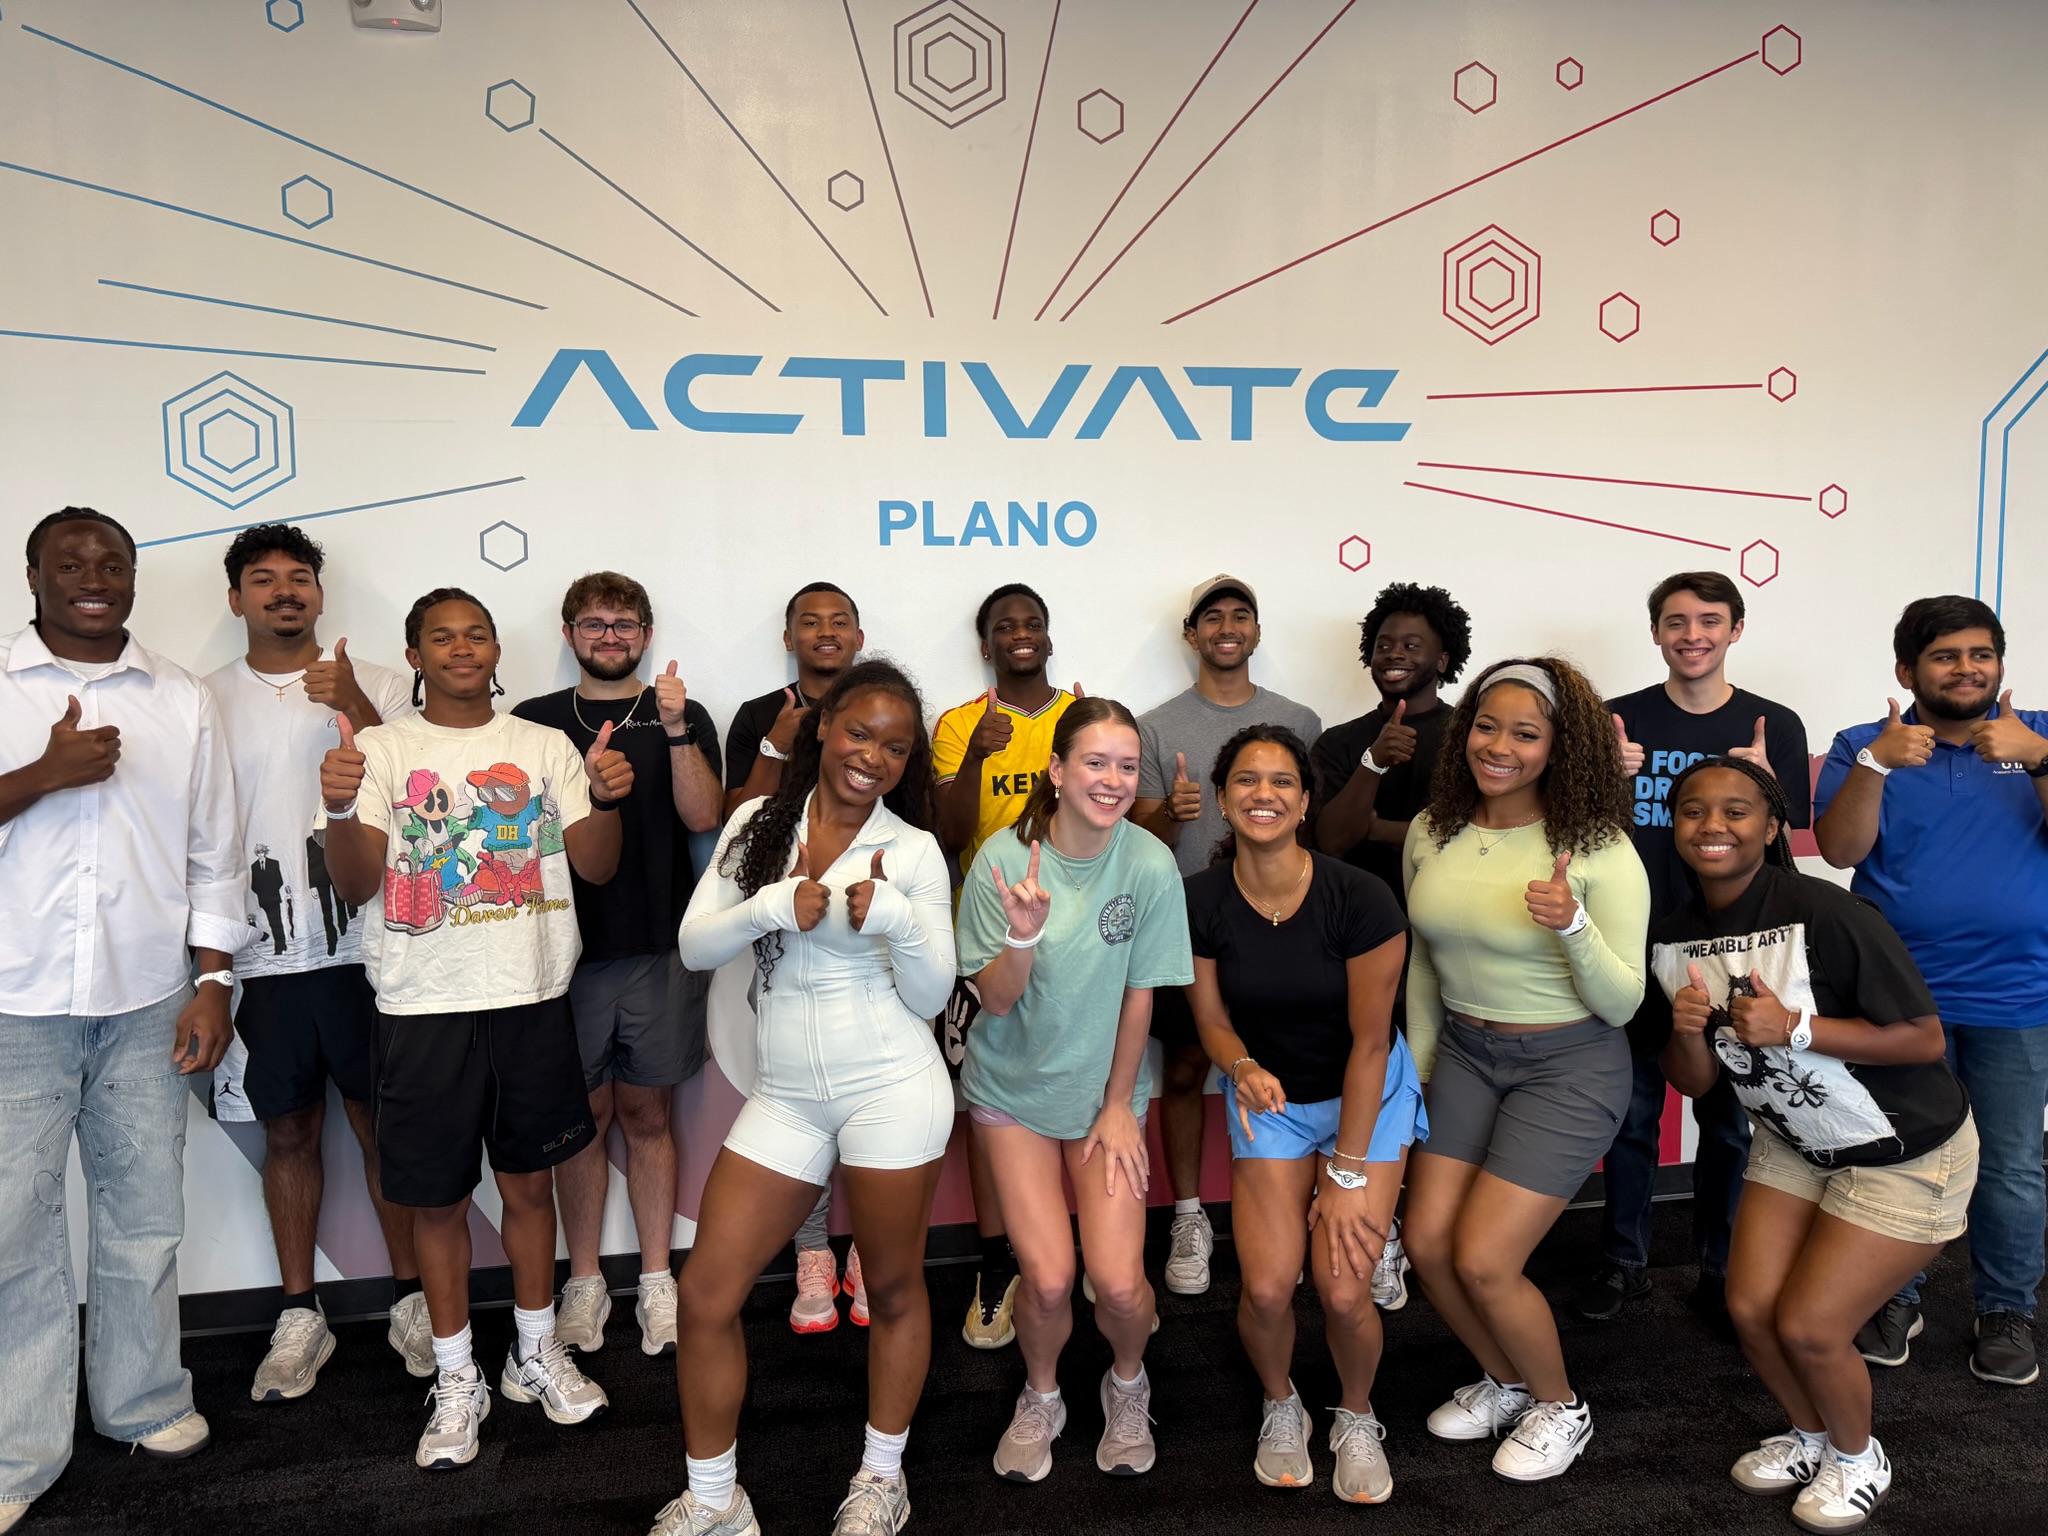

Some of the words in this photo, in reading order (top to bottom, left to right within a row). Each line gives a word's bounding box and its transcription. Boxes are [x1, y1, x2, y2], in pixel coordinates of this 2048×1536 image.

[513, 350, 1411, 441] ACTIVATE
[880, 501, 1097, 546] PLANO
[1651, 750, 1721, 776] FOO
[992, 770, 1045, 797] KEN
[1635, 775, 1673, 801] DR
[1633, 801, 1674, 828] SM
[496, 825, 519, 841] DH
[448, 904, 518, 927] Daven
[542, 1120, 586, 1153] BLACK
